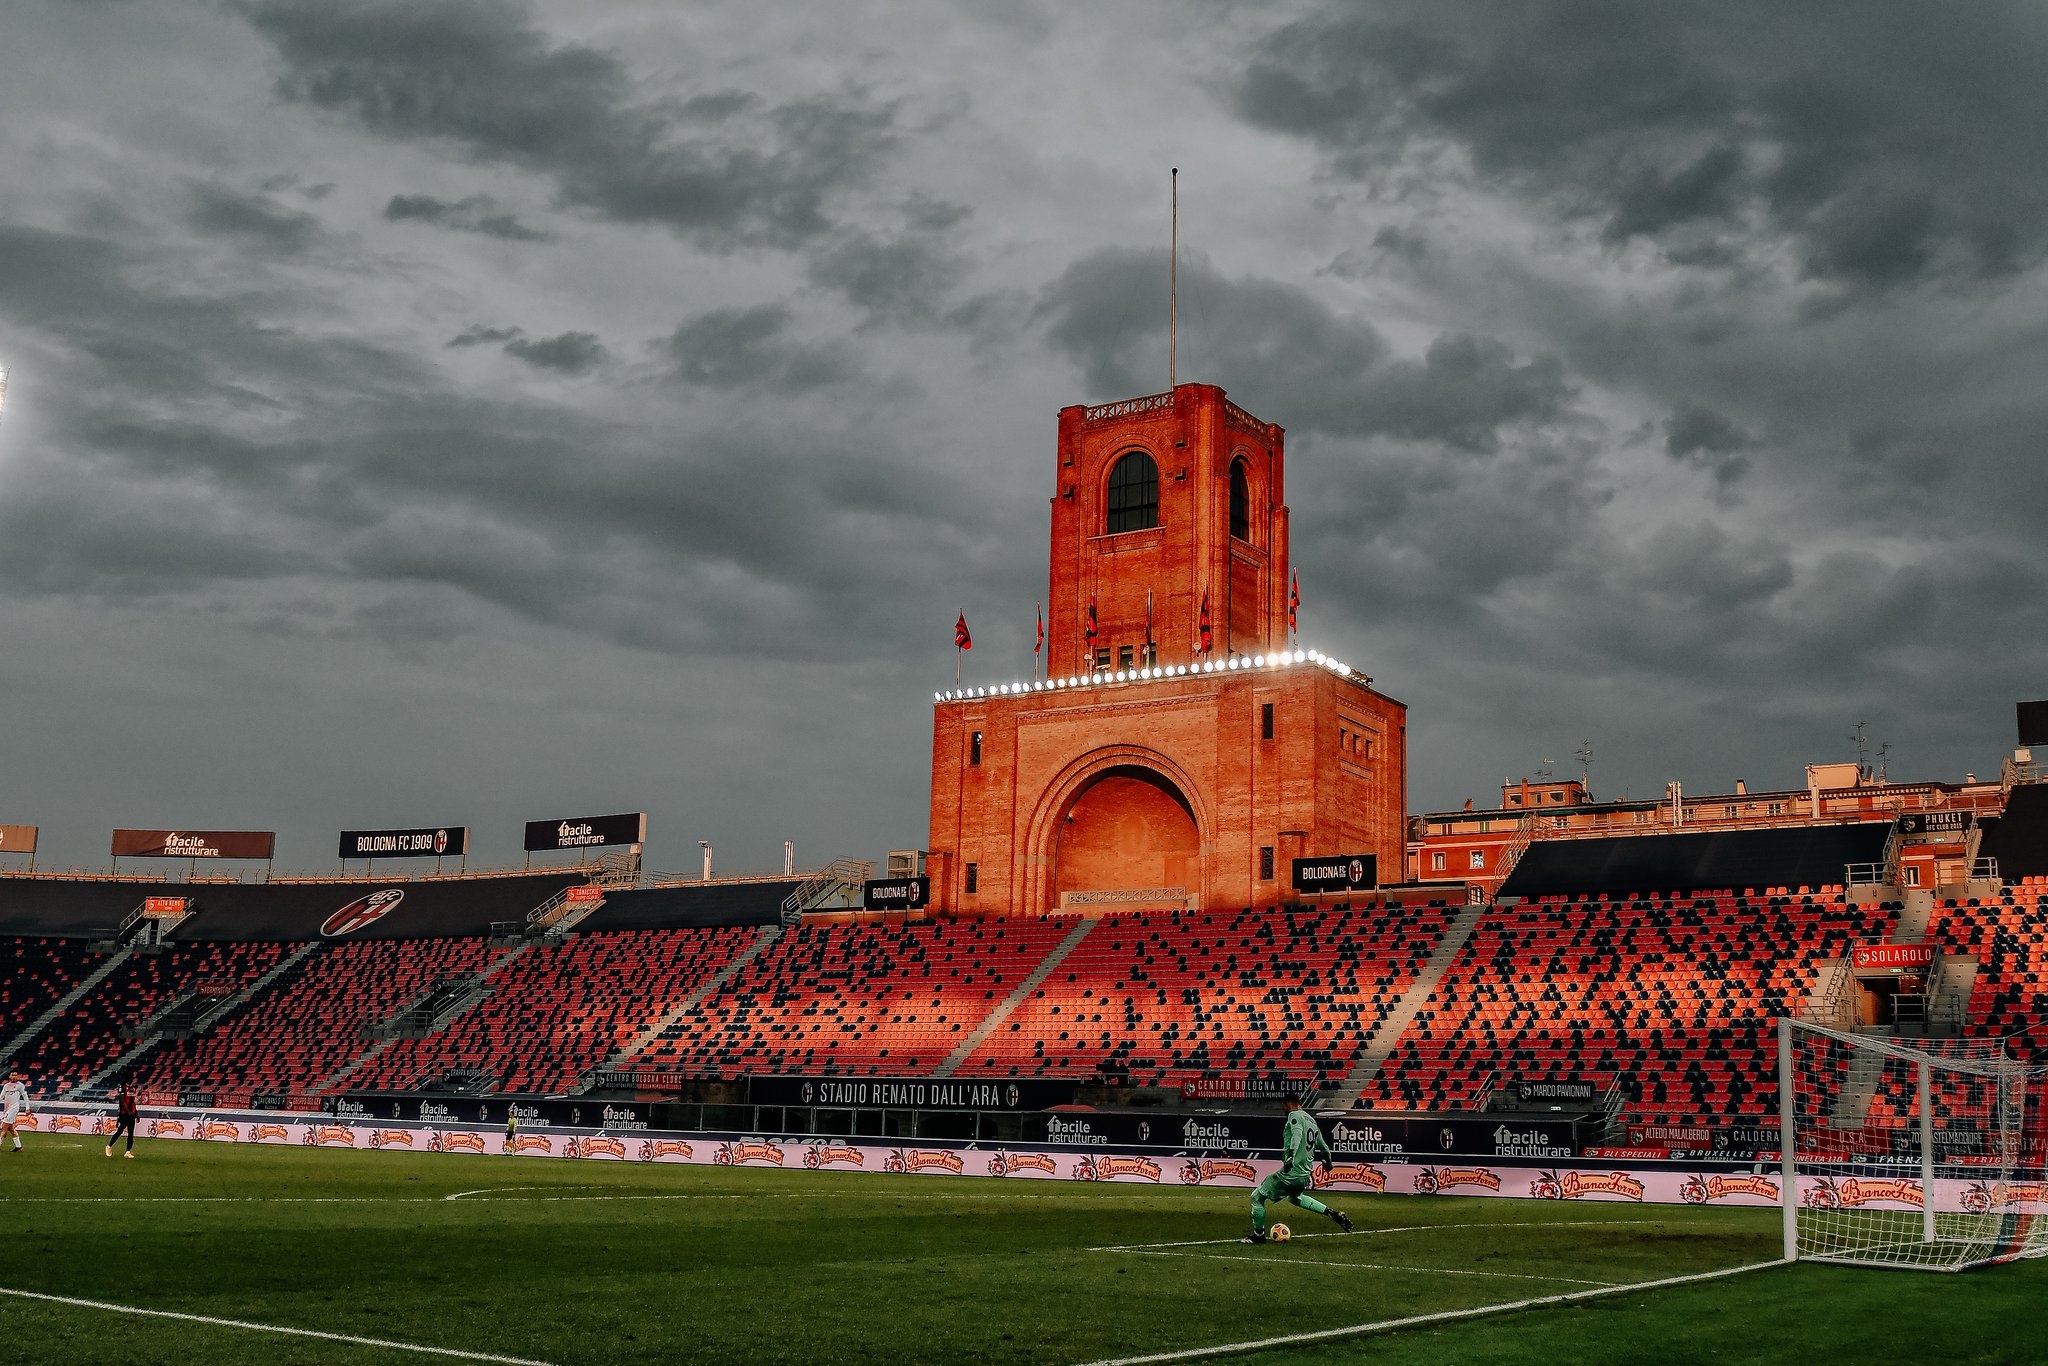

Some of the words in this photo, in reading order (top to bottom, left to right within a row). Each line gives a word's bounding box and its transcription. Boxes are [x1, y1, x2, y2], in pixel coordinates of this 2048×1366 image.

[1926, 813, 1962, 824] PHUKET
[558, 820, 592, 836] facile
[165, 832, 204, 847] facile
[357, 836, 396, 851] BOLOGNA
[398, 835, 409, 850] FC
[411, 834, 432, 850] 1909
[558, 835, 604, 846] ristrutturare
[164, 846, 219, 856] ristrutturare
[1303, 866, 1338, 880] BOLOGNA
[873, 887, 901, 899] BOLOGNA
[1871, 949, 1932, 962] SOLAROLO
[606, 1074, 629, 1082] CENTRO
[632, 1074, 659, 1083] BOLOGNA
[662, 1075, 682, 1084] CLUBS
[1198, 1080, 1231, 1090] CENTRO
[1236, 1081, 1275, 1091] BOLOGNA
[1280, 1081, 1309, 1091] CLUBS
[820, 1083, 866, 1103] STADIO
[873, 1084, 925, 1104] RENATO
[931, 1085, 999, 1106] DALL'ARA
[1533, 1084, 1556, 1097] MARCO
[1557, 1085, 1591, 1098] PAVIGNANI
[337, 1098, 364, 1112] facile
[420, 1100, 448, 1114] facile
[420, 1114, 459, 1122] ristrutturare
[603, 1104, 635, 1120] facile
[603, 1120, 647, 1129] ristrutturare
[1047, 1115, 1090, 1133] facile
[1183, 1118, 1229, 1137] facile
[1331, 1121, 1382, 1141] facile
[1493, 1124, 1548, 1144] facile
[1645, 1127, 1668, 1139] ALTEDO
[1669, 1128, 1710, 1140] MALALBERGO
[1734, 1130, 1780, 1142] CALDERA
[1048, 1132, 1107, 1144] ristrutturare
[1184, 1136, 1248, 1148] ristrutturare
[1333, 1140, 1402, 1153] ristrutturare
[1496, 1144, 1571, 1157] ristrutturare
[1664, 1141, 1690, 1149] ROSSOBLU
[1604, 1150, 1620, 1158] GLI
[1621, 1151, 1661, 1159] SPECIALI
[1689, 1150, 1753, 1158] BRUXELLES
[1841, 1178, 1922, 1203] BiancoForn
